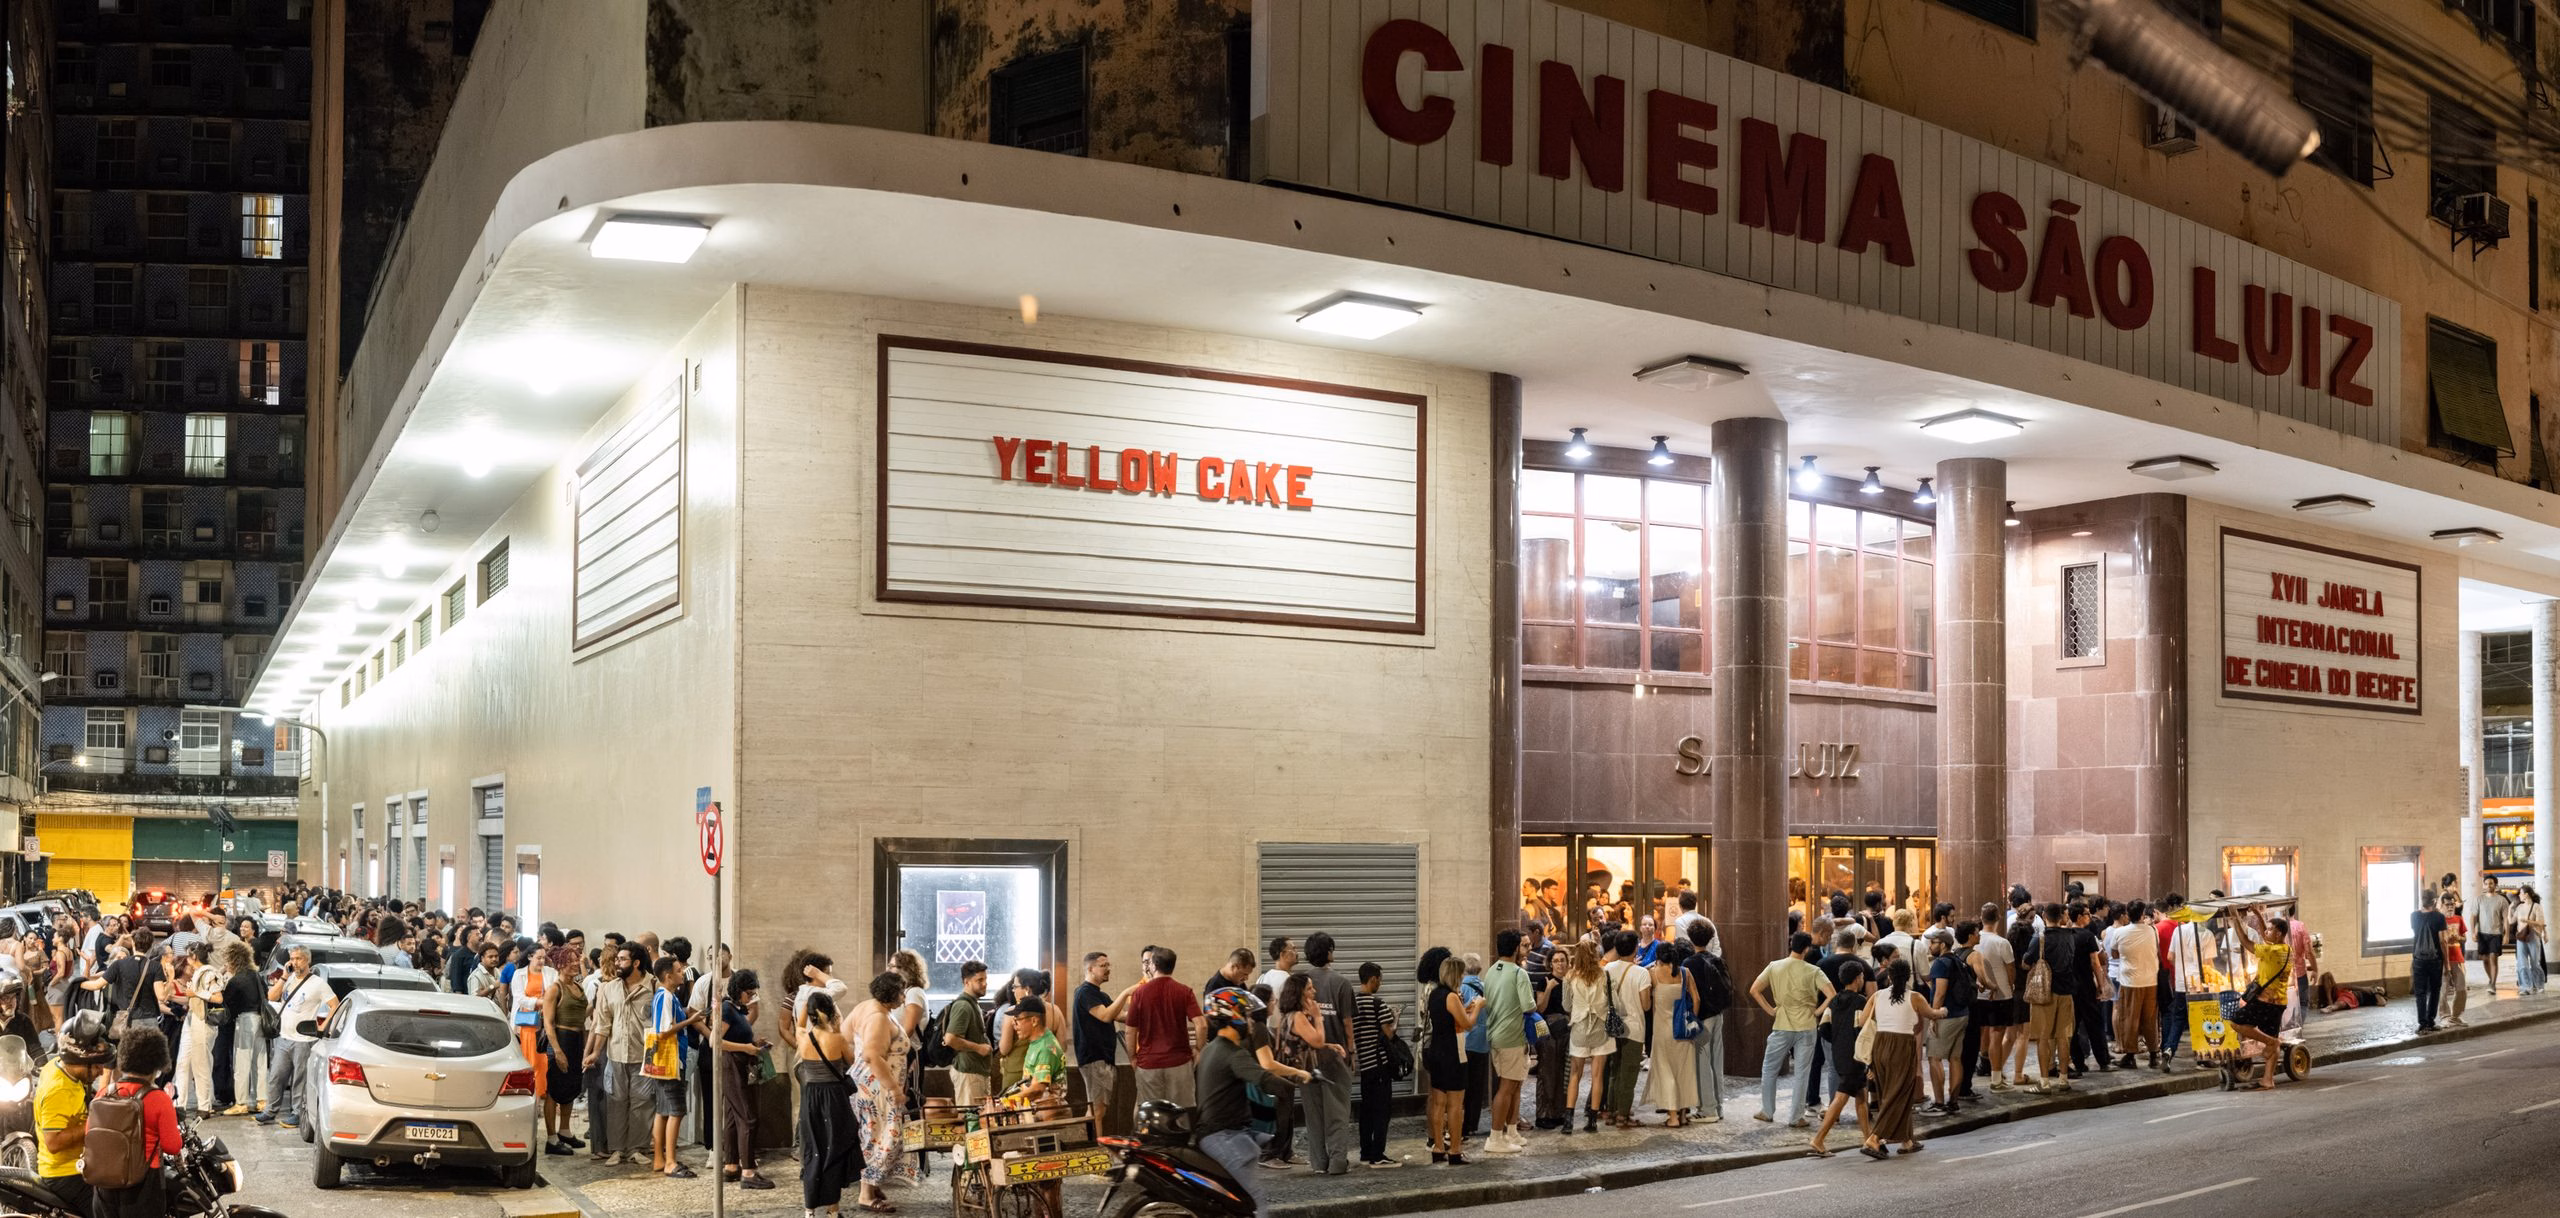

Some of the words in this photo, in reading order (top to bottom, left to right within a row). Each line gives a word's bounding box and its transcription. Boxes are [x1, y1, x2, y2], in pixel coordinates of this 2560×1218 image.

[1362, 18, 1915, 267] CINEMA
[1968, 191, 2154, 331] SÃO
[2193, 266, 2374, 407] LUIZ
[992, 435, 1178, 496] YELLOW
[1198, 456, 1313, 508] CAKE
[2271, 571, 2308, 605] XVII
[2317, 581, 2384, 617] JANELA
[2257, 614, 2400, 660] INTERNACIONAL
[2226, 655, 2252, 686] DE
[2255, 658, 2322, 693] CINEMA
[2327, 667, 2350, 696] DO
[2355, 671, 2416, 703] RECIFE
[411, 1127, 454, 1139] QYE9C21
